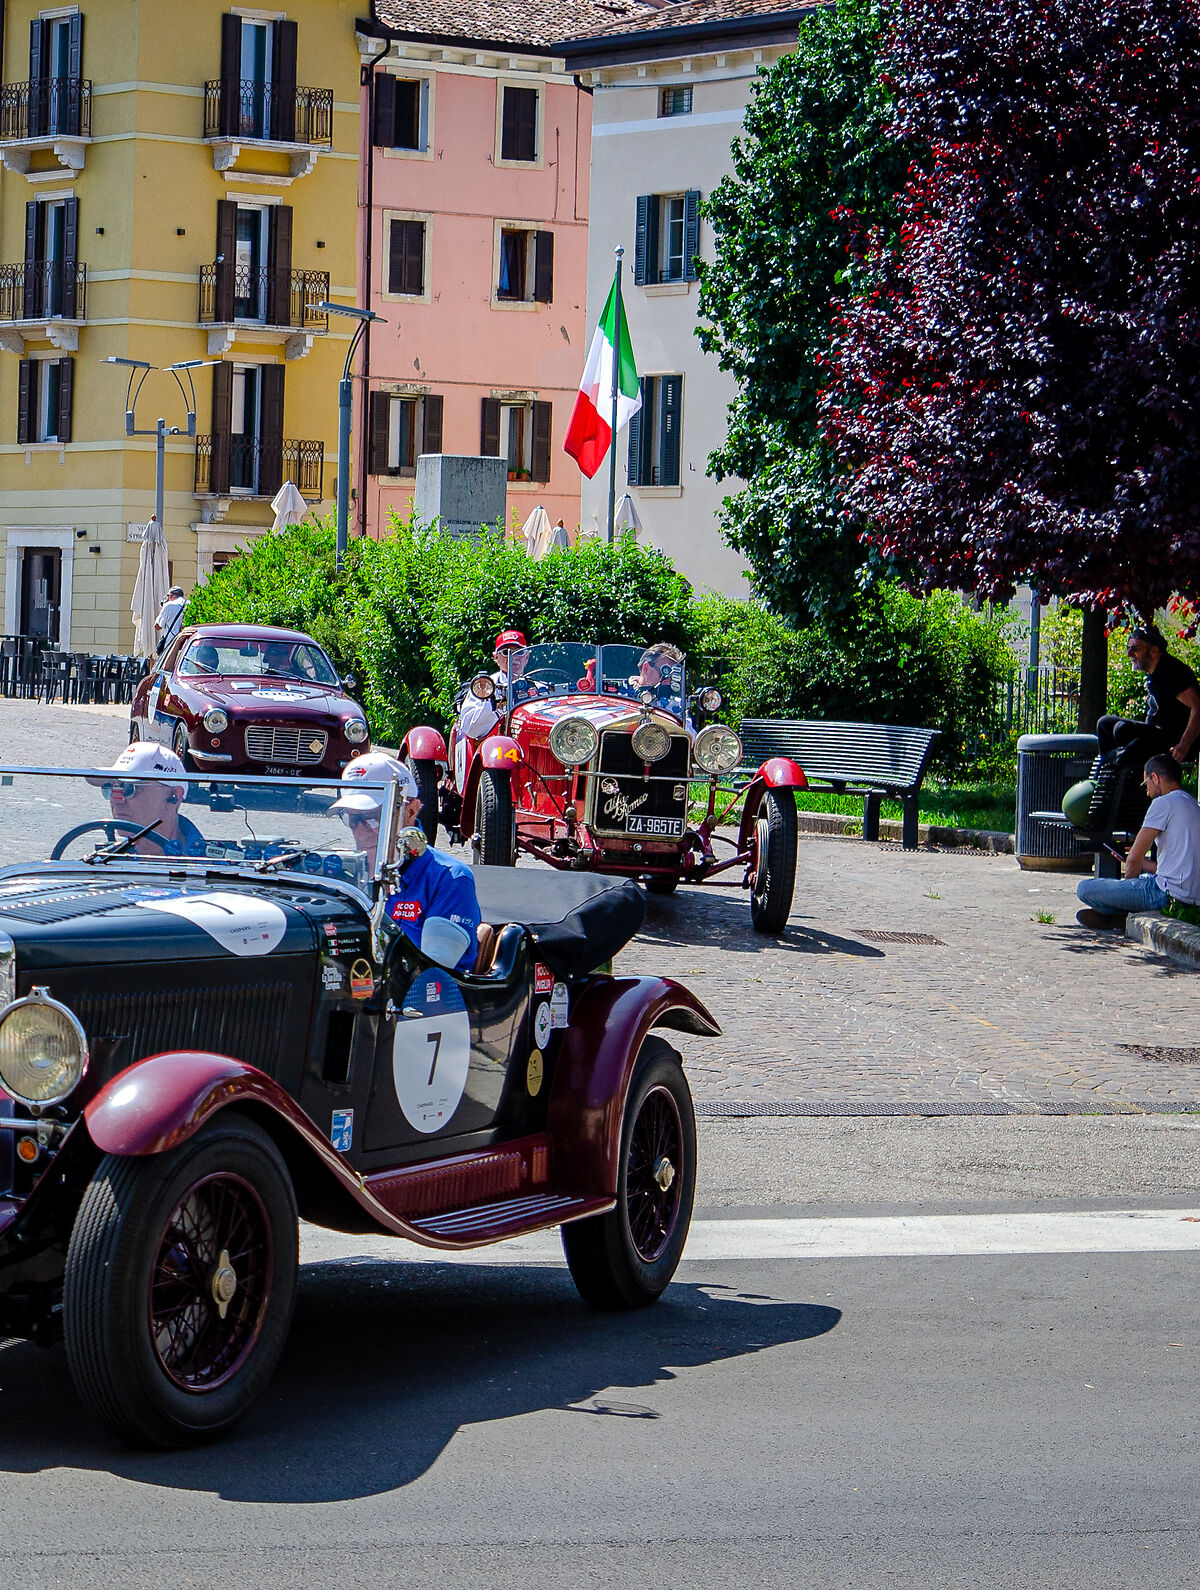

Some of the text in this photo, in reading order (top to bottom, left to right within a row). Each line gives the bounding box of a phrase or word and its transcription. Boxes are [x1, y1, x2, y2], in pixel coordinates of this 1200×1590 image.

[493, 746, 520, 763] 14
[603, 791, 629, 820] Alfa
[629, 817, 680, 835] ZA-965TE
[426, 1031, 443, 1086] 7
